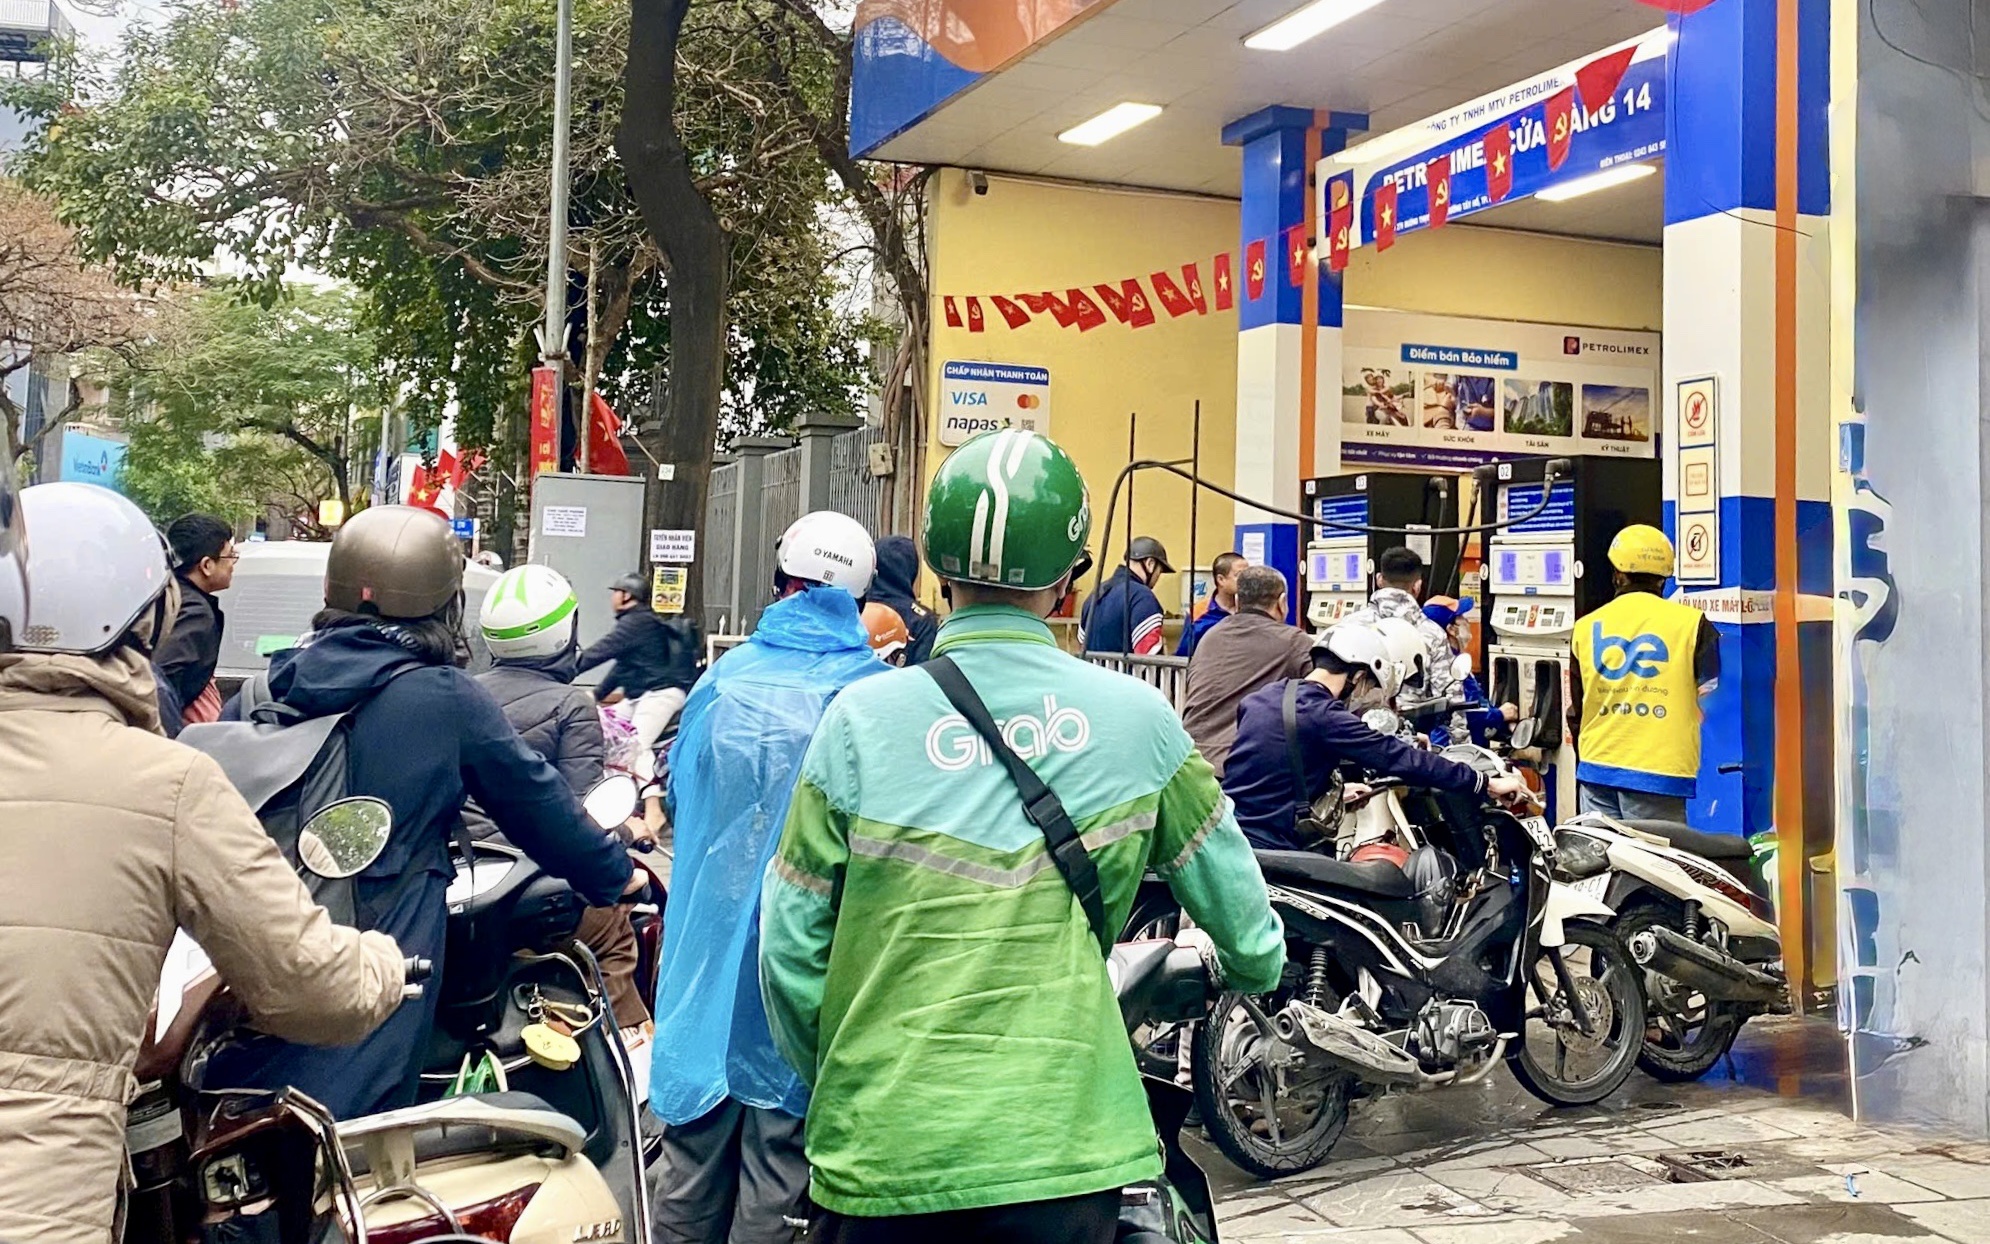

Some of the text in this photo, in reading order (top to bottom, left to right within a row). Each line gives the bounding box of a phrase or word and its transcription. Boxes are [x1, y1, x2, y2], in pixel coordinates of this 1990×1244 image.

[1450, 113, 1461, 127] TY
[1463, 104, 1485, 121] TNHH
[1488, 97, 1507, 113] MTV
[1509, 77, 1566, 105] PETROLIME
[1383, 140, 1487, 194] PETRIME
[1569, 97, 1617, 135] ÀNG
[1623, 81, 1652, 116] 14
[1409, 347, 1510, 366] Điểm bán Bảo hiểm
[1582, 342, 1649, 355] PETROLIMEX
[946, 364, 1048, 382] CHẤP NHẬN THANH TOÁN
[951, 391, 988, 406] VISA
[947, 416, 999, 434] napas
[1500, 466, 1509, 477] 02
[823, 550, 853, 568] YAMAHA
[1709, 599, 1720, 612] XE
[1593, 621, 1670, 680] be
[925, 694, 1091, 771] Grab
